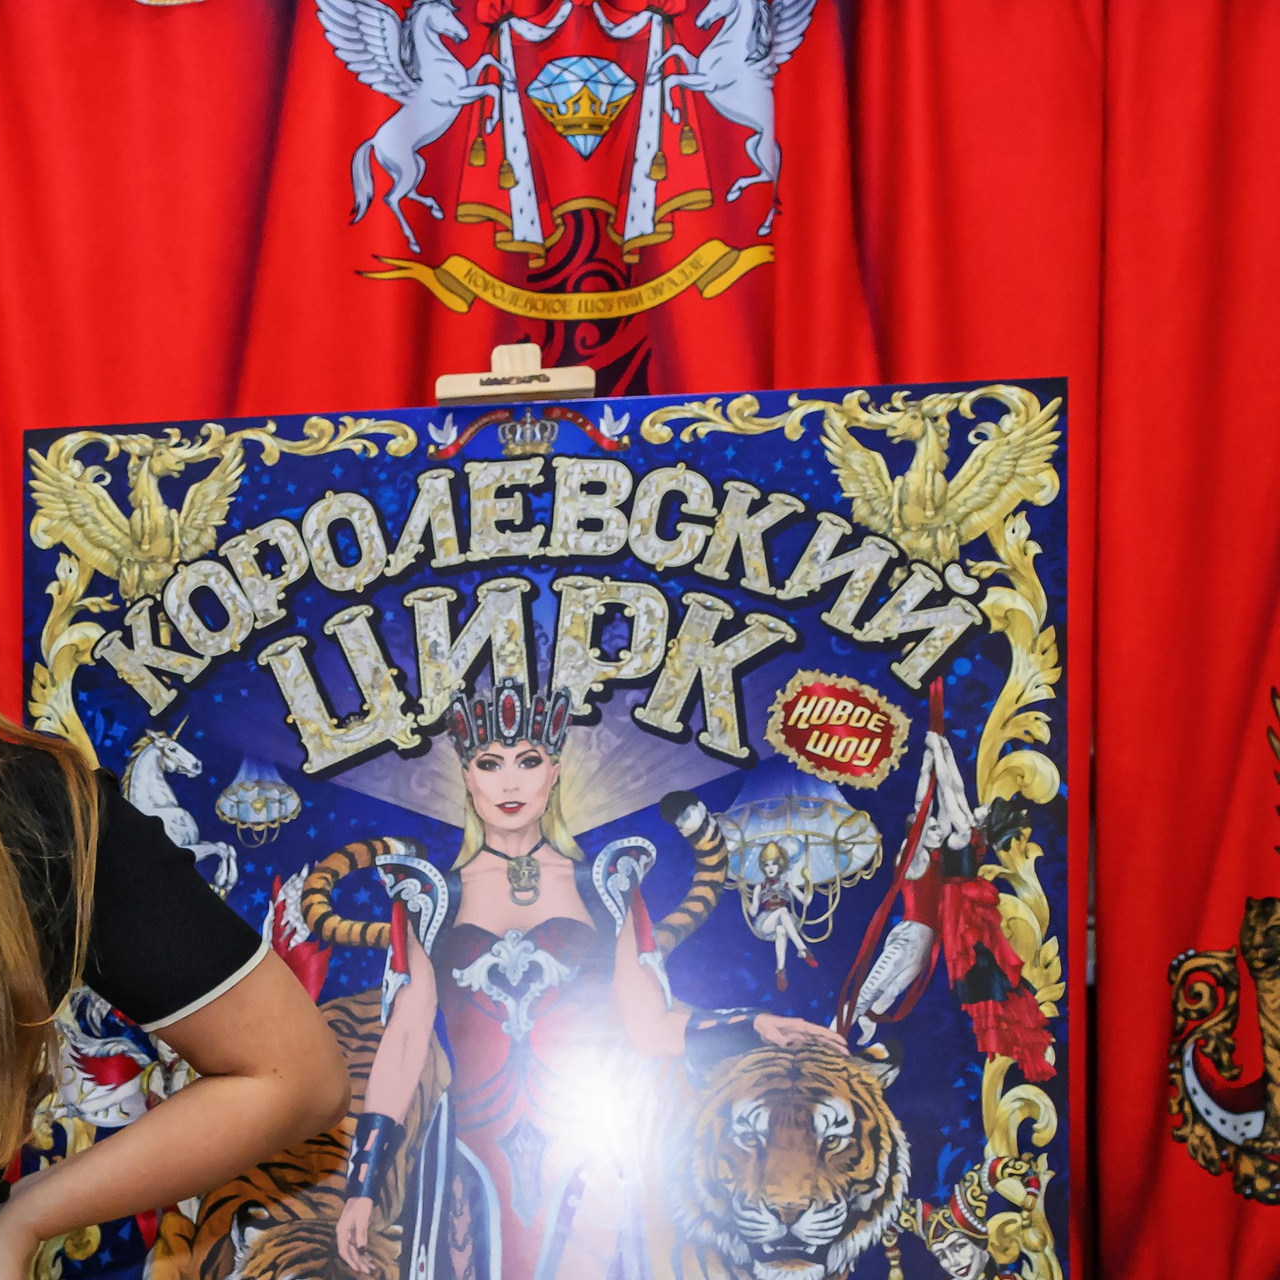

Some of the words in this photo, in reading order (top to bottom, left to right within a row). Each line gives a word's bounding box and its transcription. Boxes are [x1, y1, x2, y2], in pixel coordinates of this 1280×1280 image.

[94, 456, 988, 718] КОРОЛЕВСКИЙ
[258, 575, 797, 775] ЦИРК
[786, 695, 888, 734] НОВОЕ
[805, 729, 882, 767] ШОУ
